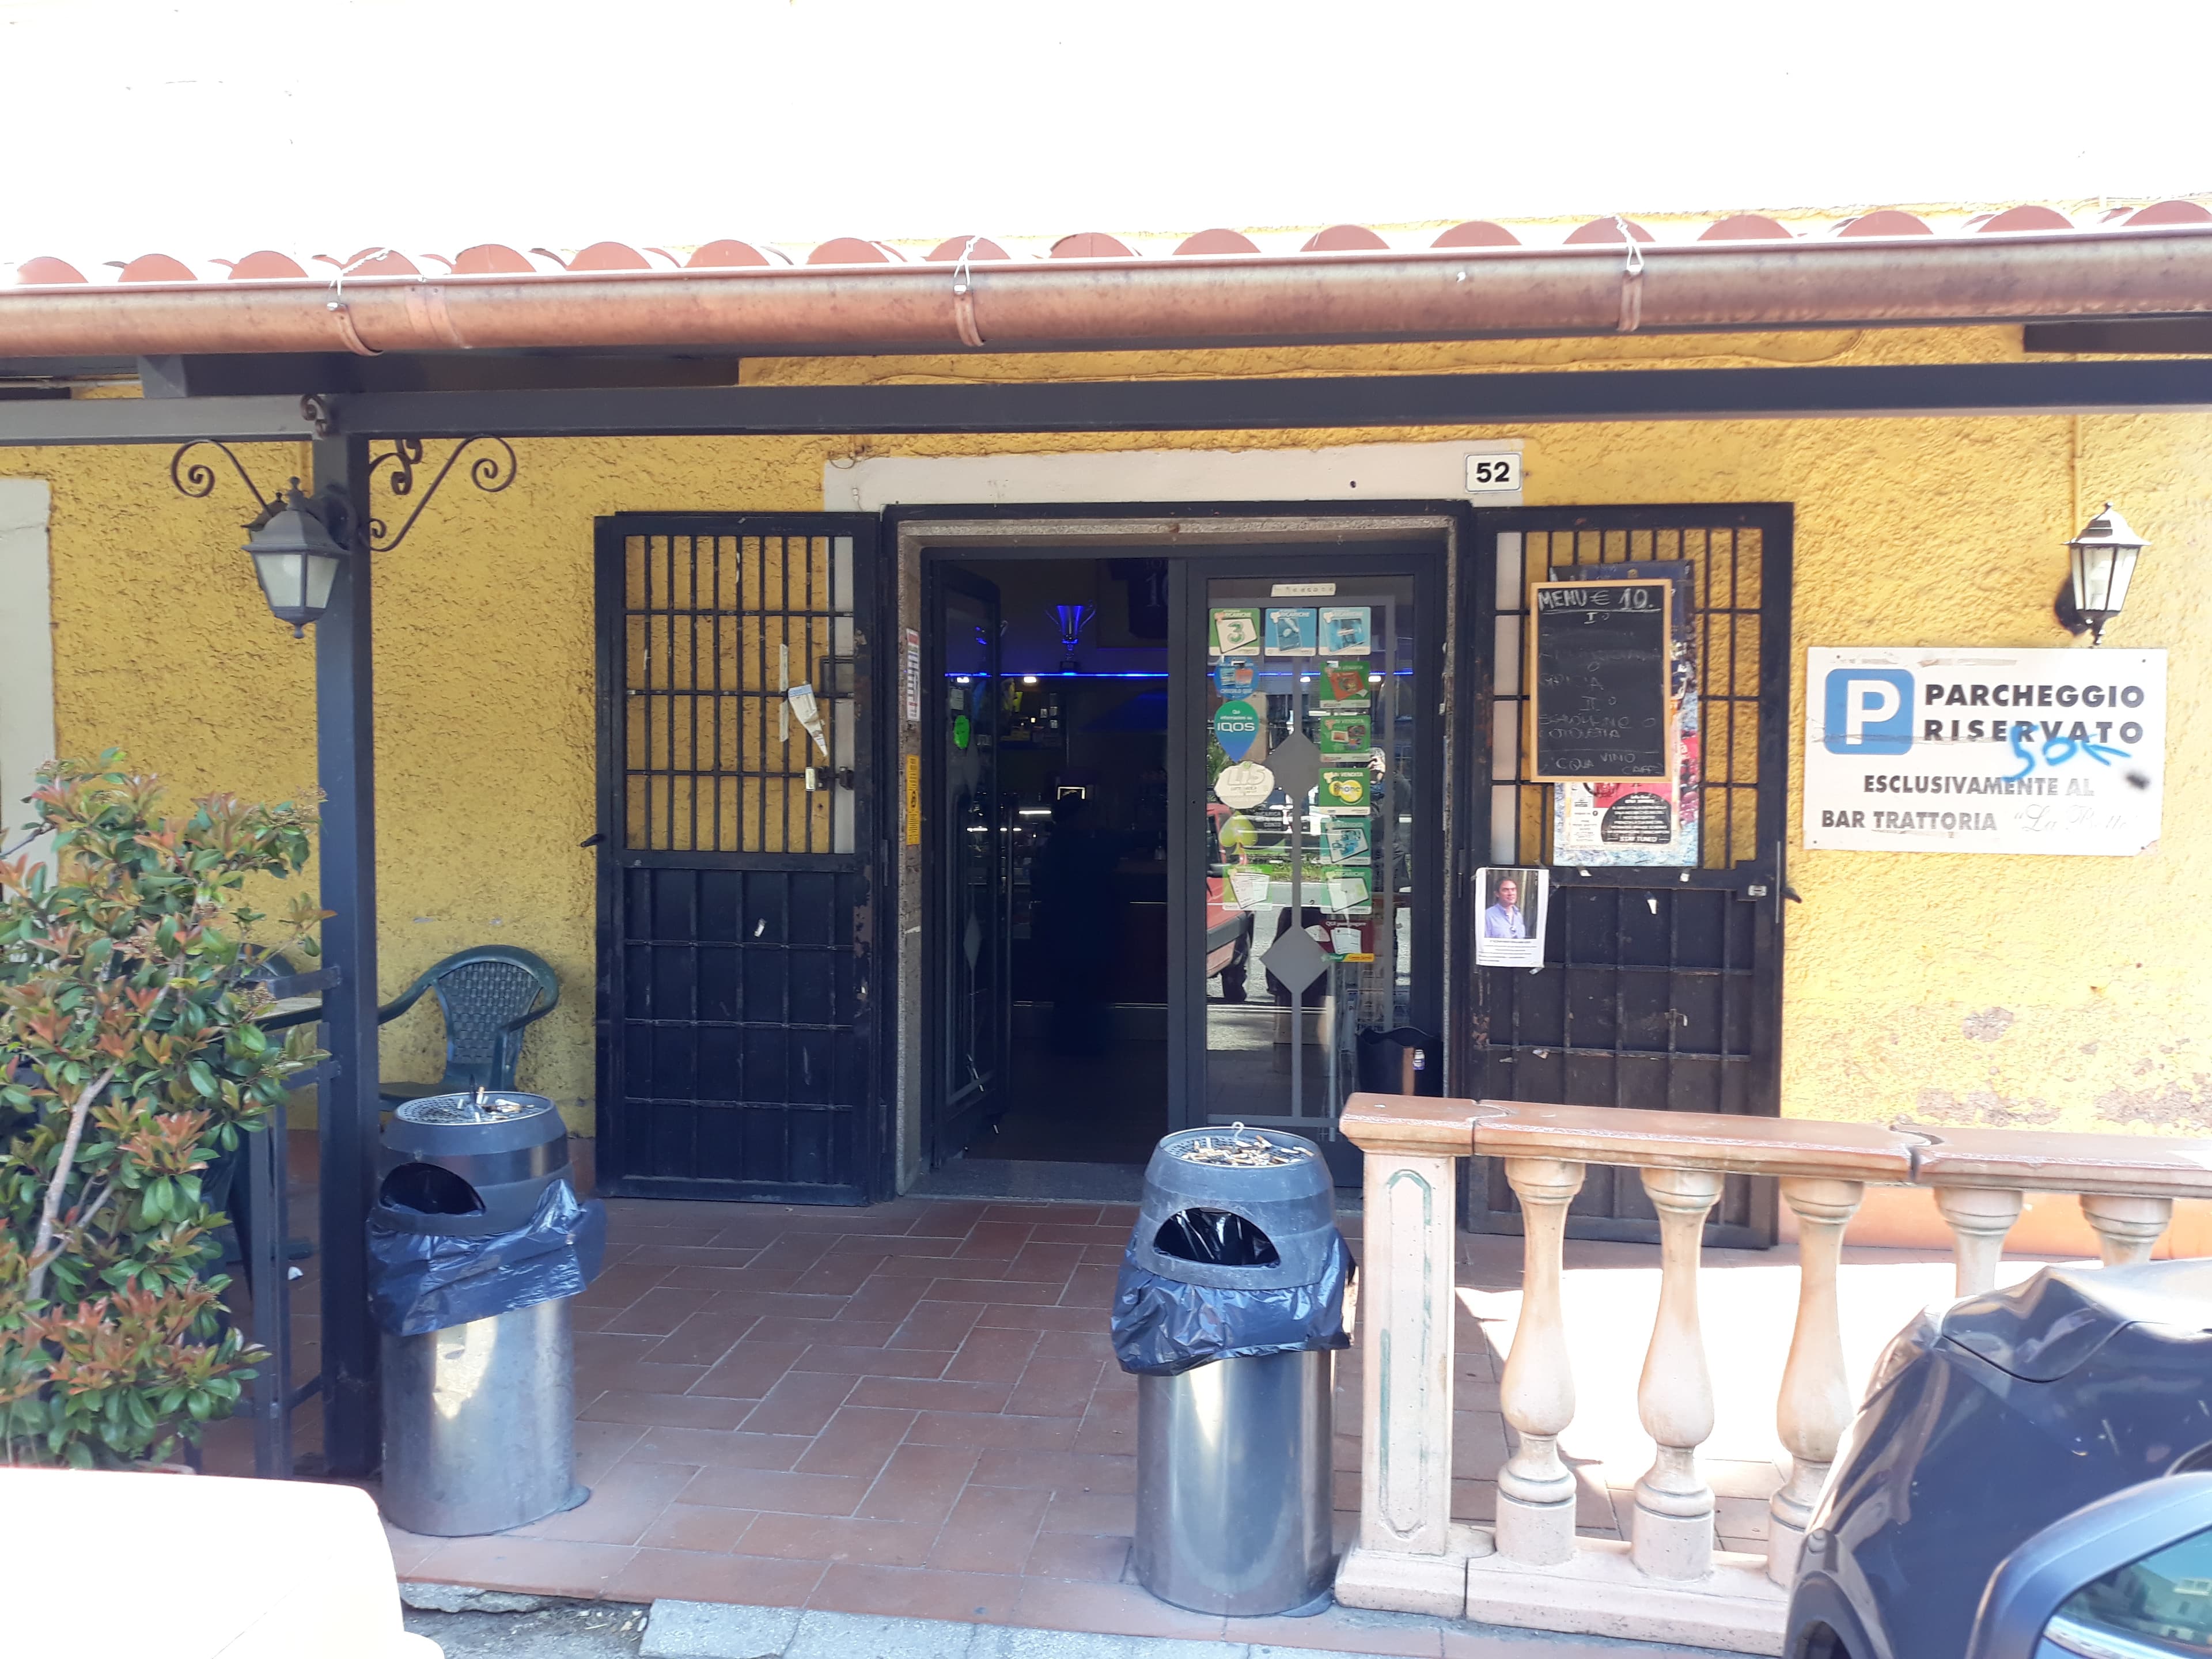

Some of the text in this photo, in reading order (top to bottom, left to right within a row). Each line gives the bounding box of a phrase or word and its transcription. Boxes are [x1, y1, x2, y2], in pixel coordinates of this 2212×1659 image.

[1476, 461, 1509, 483] 52
[1539, 589, 1587, 611] MENU
[1925, 683, 2145, 709] PARCHEGGIO
[1846, 680, 1900, 745] P
[1217, 722, 1255, 732] IQOS
[1923, 719, 2144, 744] RISERVATO
[1600, 752, 1636, 763] VINO
[1863, 775, 2095, 796] ESCLUSIVAMENTE AL
[1821, 810, 1866, 828] BAR
[1873, 810, 1997, 830] TRATTORIA
